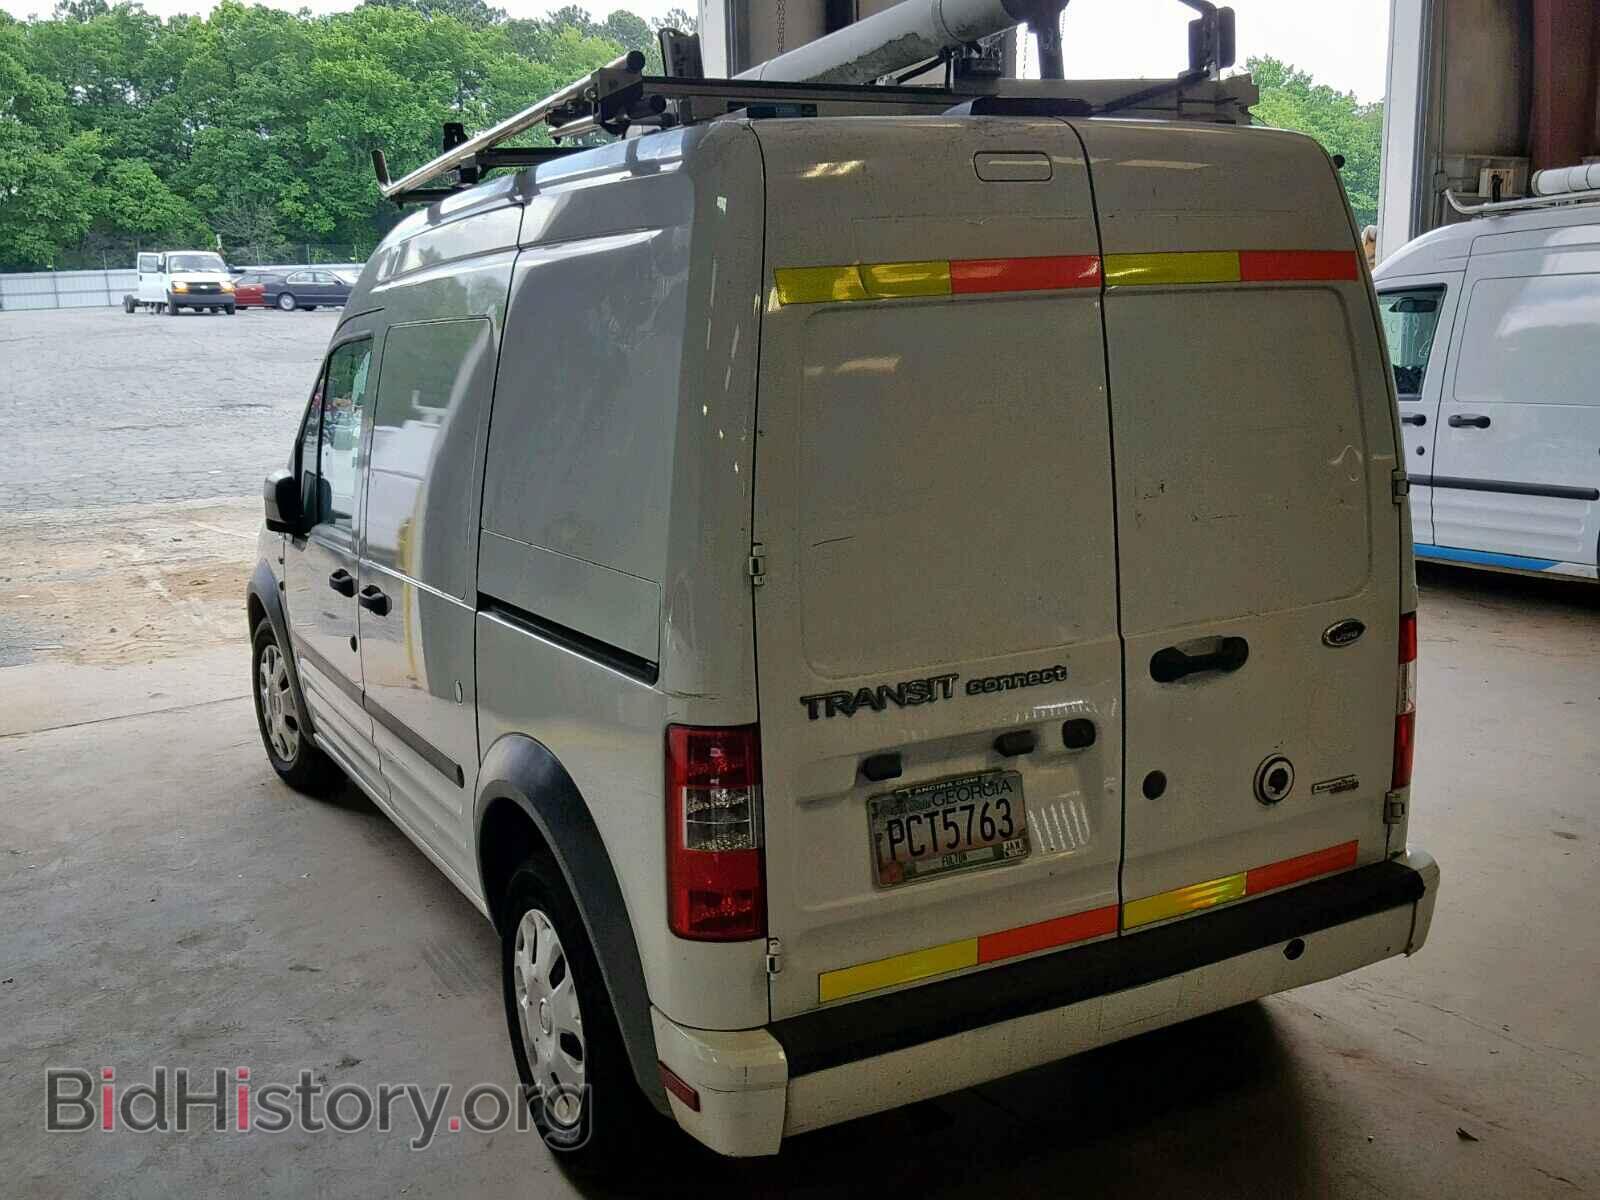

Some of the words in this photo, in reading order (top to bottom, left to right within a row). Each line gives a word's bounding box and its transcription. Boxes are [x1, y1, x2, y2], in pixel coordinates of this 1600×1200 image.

[800, 673, 959, 721] TRANSIT
[966, 664, 1067, 696] connect
[931, 779, 1013, 807] GEORGIA
[887, 797, 1015, 862] PCT5763
